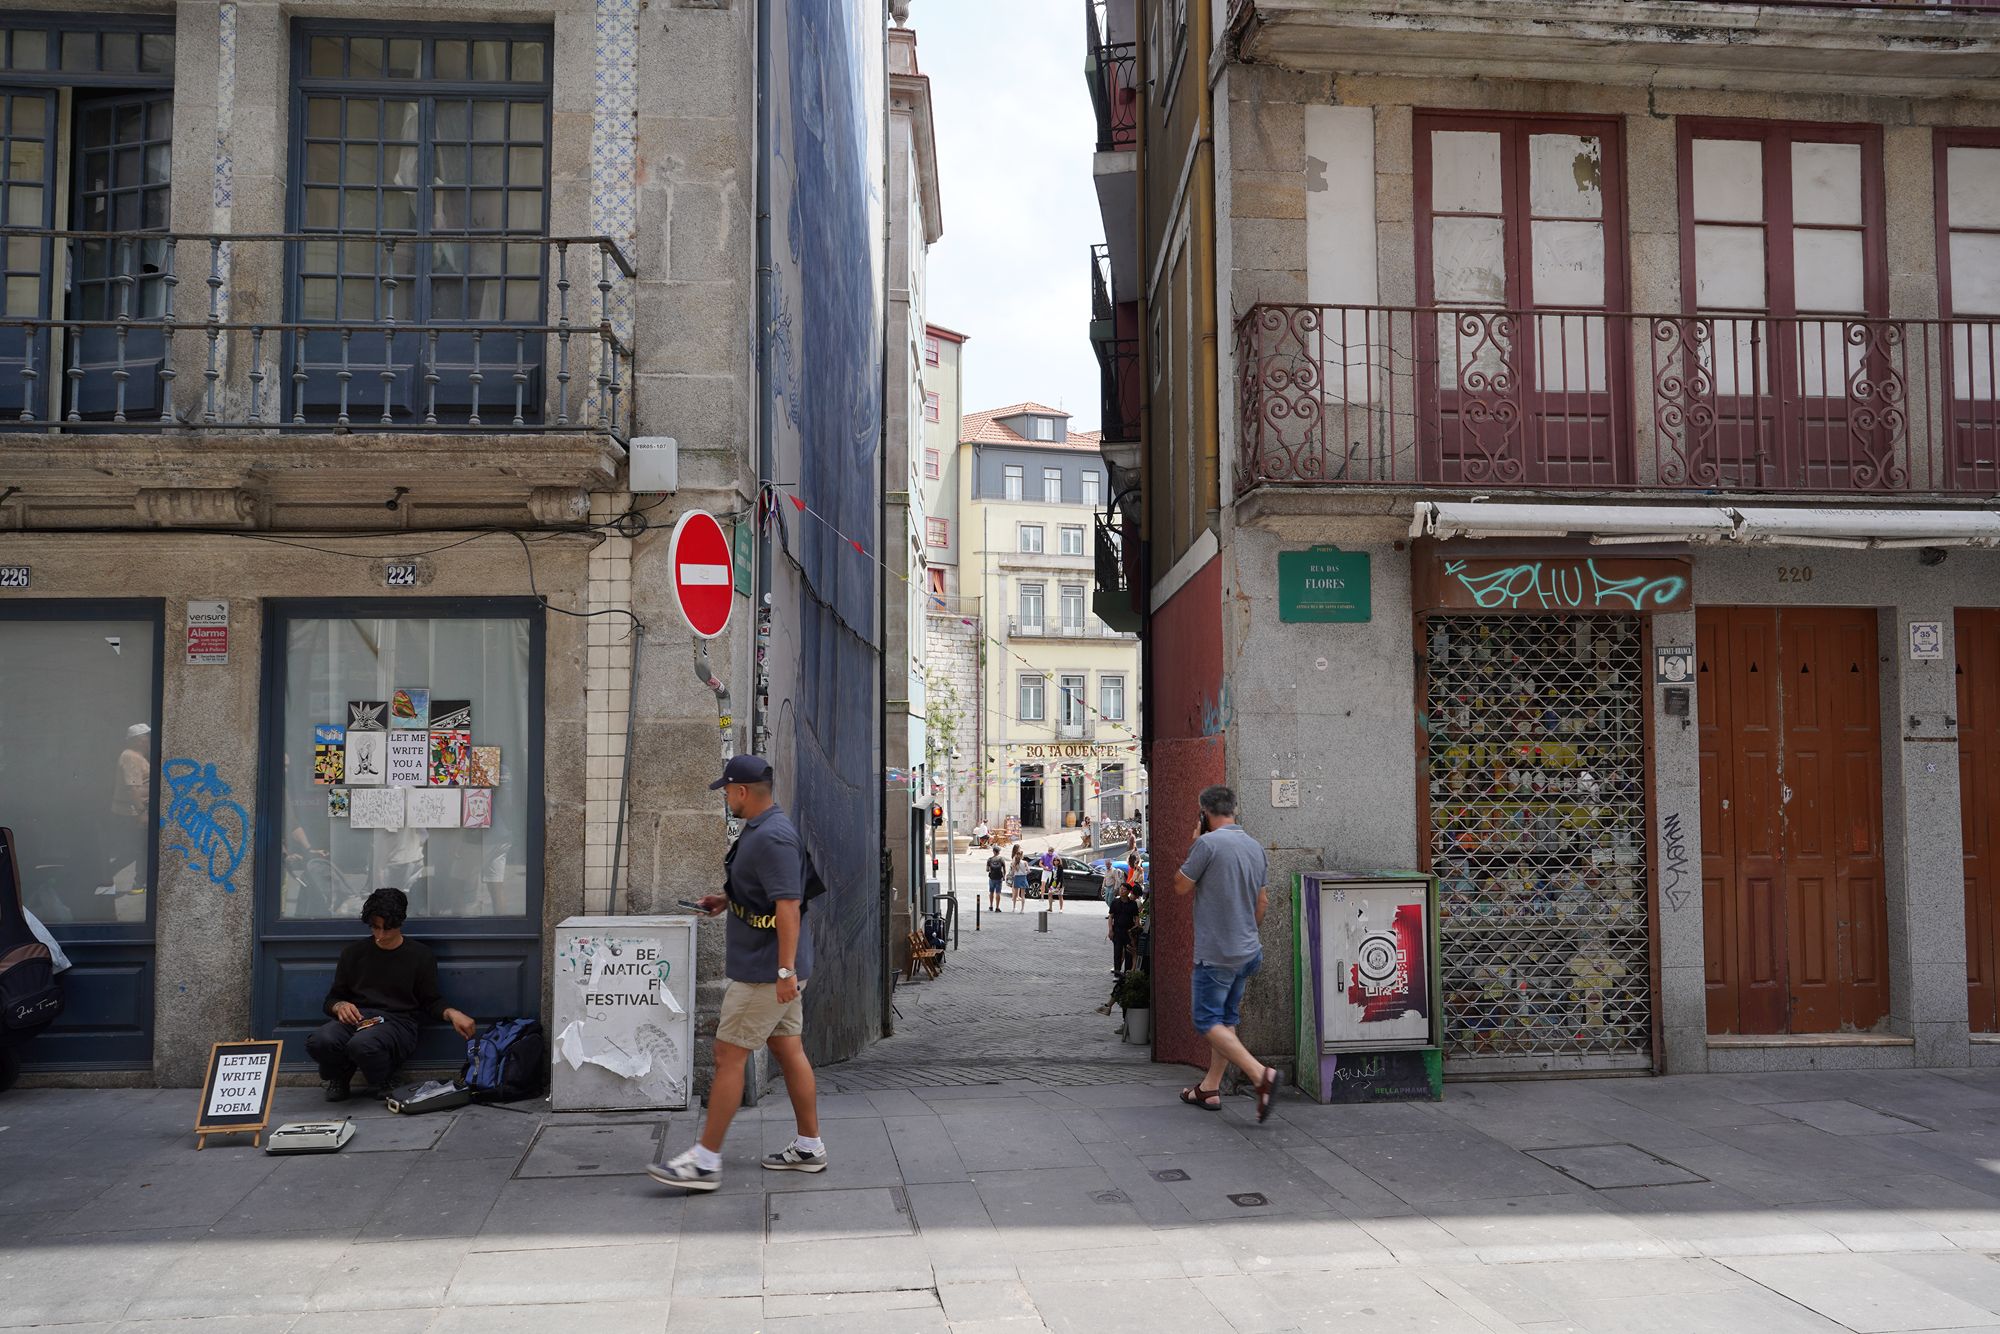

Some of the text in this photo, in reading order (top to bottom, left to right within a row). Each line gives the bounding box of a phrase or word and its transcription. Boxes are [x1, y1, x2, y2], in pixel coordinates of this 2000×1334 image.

[1310, 565, 1340, 573] RUA DAS
[1778, 566, 1813, 583] 220
[0, 568, 28, 586] 226
[388, 566, 414, 584] 224
[1305, 578, 1345, 589] FLORES
[190, 628, 226, 637] Alarme
[391, 734, 426, 742] LET ME
[392, 747, 424, 755] WRITE
[393, 760, 423, 768] YOU A
[392, 773, 422, 781] POEM.
[585, 993, 660, 1006] FESTIVAL
[223, 1055, 267, 1067] LET ME
[222, 1071, 262, 1082] WRITE
[220, 1086, 257, 1098] YOU A
[215, 1102, 254, 1113] POEM.
